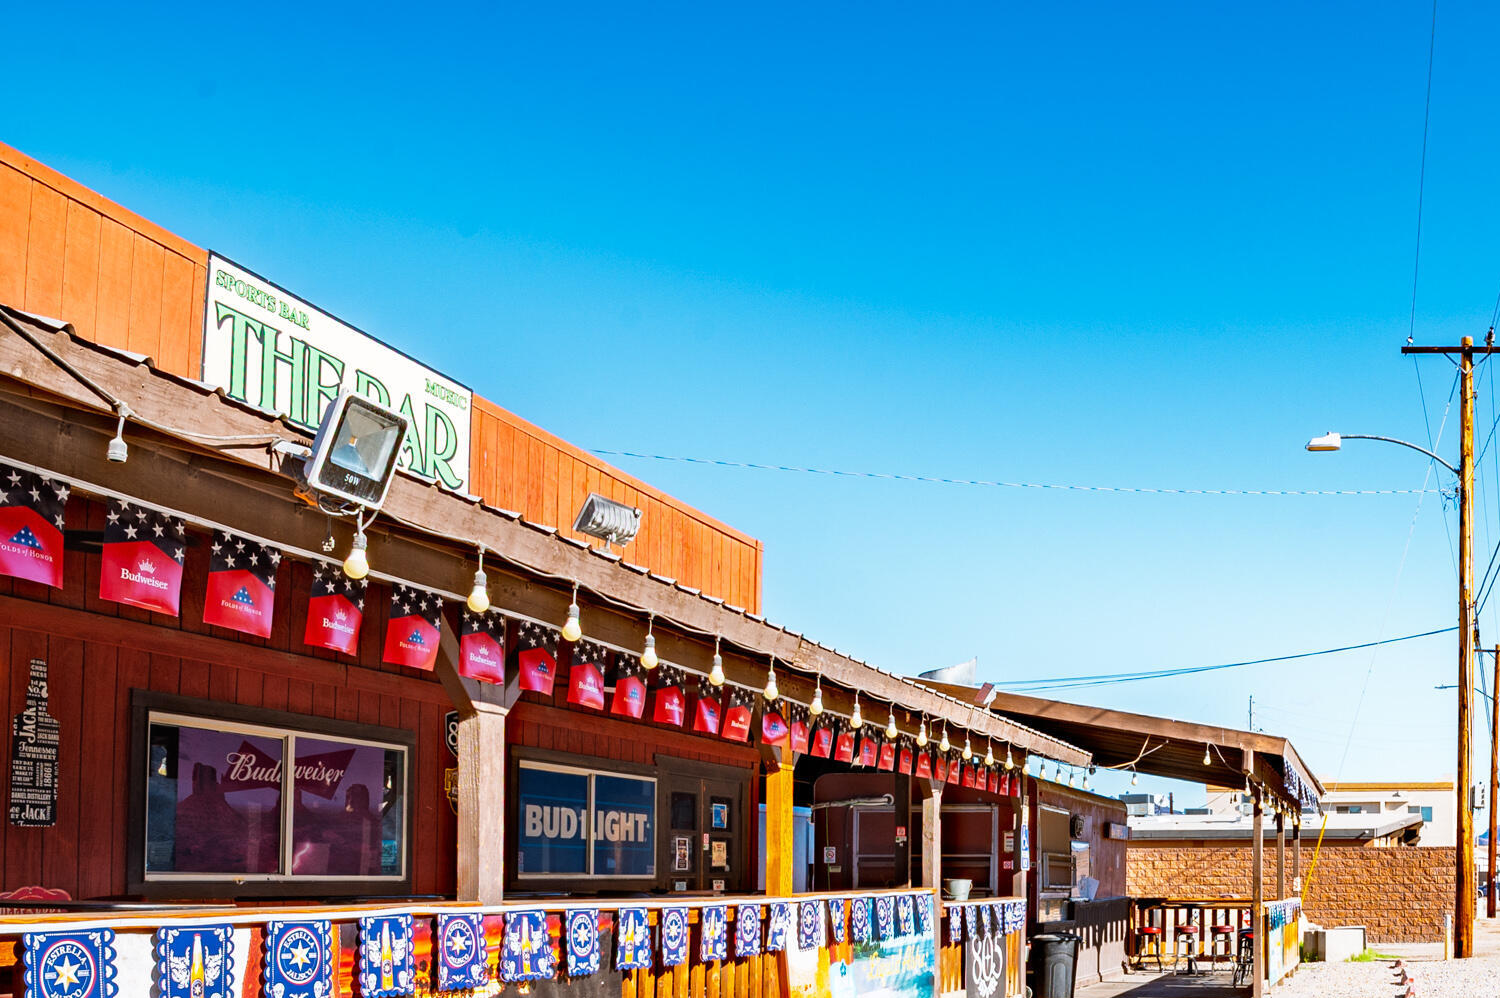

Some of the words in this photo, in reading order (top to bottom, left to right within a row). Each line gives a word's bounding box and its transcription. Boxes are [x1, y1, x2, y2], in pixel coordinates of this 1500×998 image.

[215, 269, 277, 313] SPORTS
[279, 300, 311, 331] BAR
[425, 378, 468, 410] MUSIC
[344, 473, 360, 486] 50W
[0, 542, 21, 554] OLDS
[30, 549, 53, 562] HONOR
[120, 567, 169, 590] Budweiser
[19, 707, 36, 743] JACK
[18, 741, 57, 755] Tennessee
[44, 767, 52, 787] 1866
[21, 804, 46, 820] JACK
[525, 804, 578, 839] BUD
[580, 808, 648, 842] LIGHT
[283, 930, 316, 949] ESTRELLA
[46, 945, 87, 967] ESTRELLA
[972, 932, 1003, 985] 805
[286, 968, 314, 981] JALISCO
